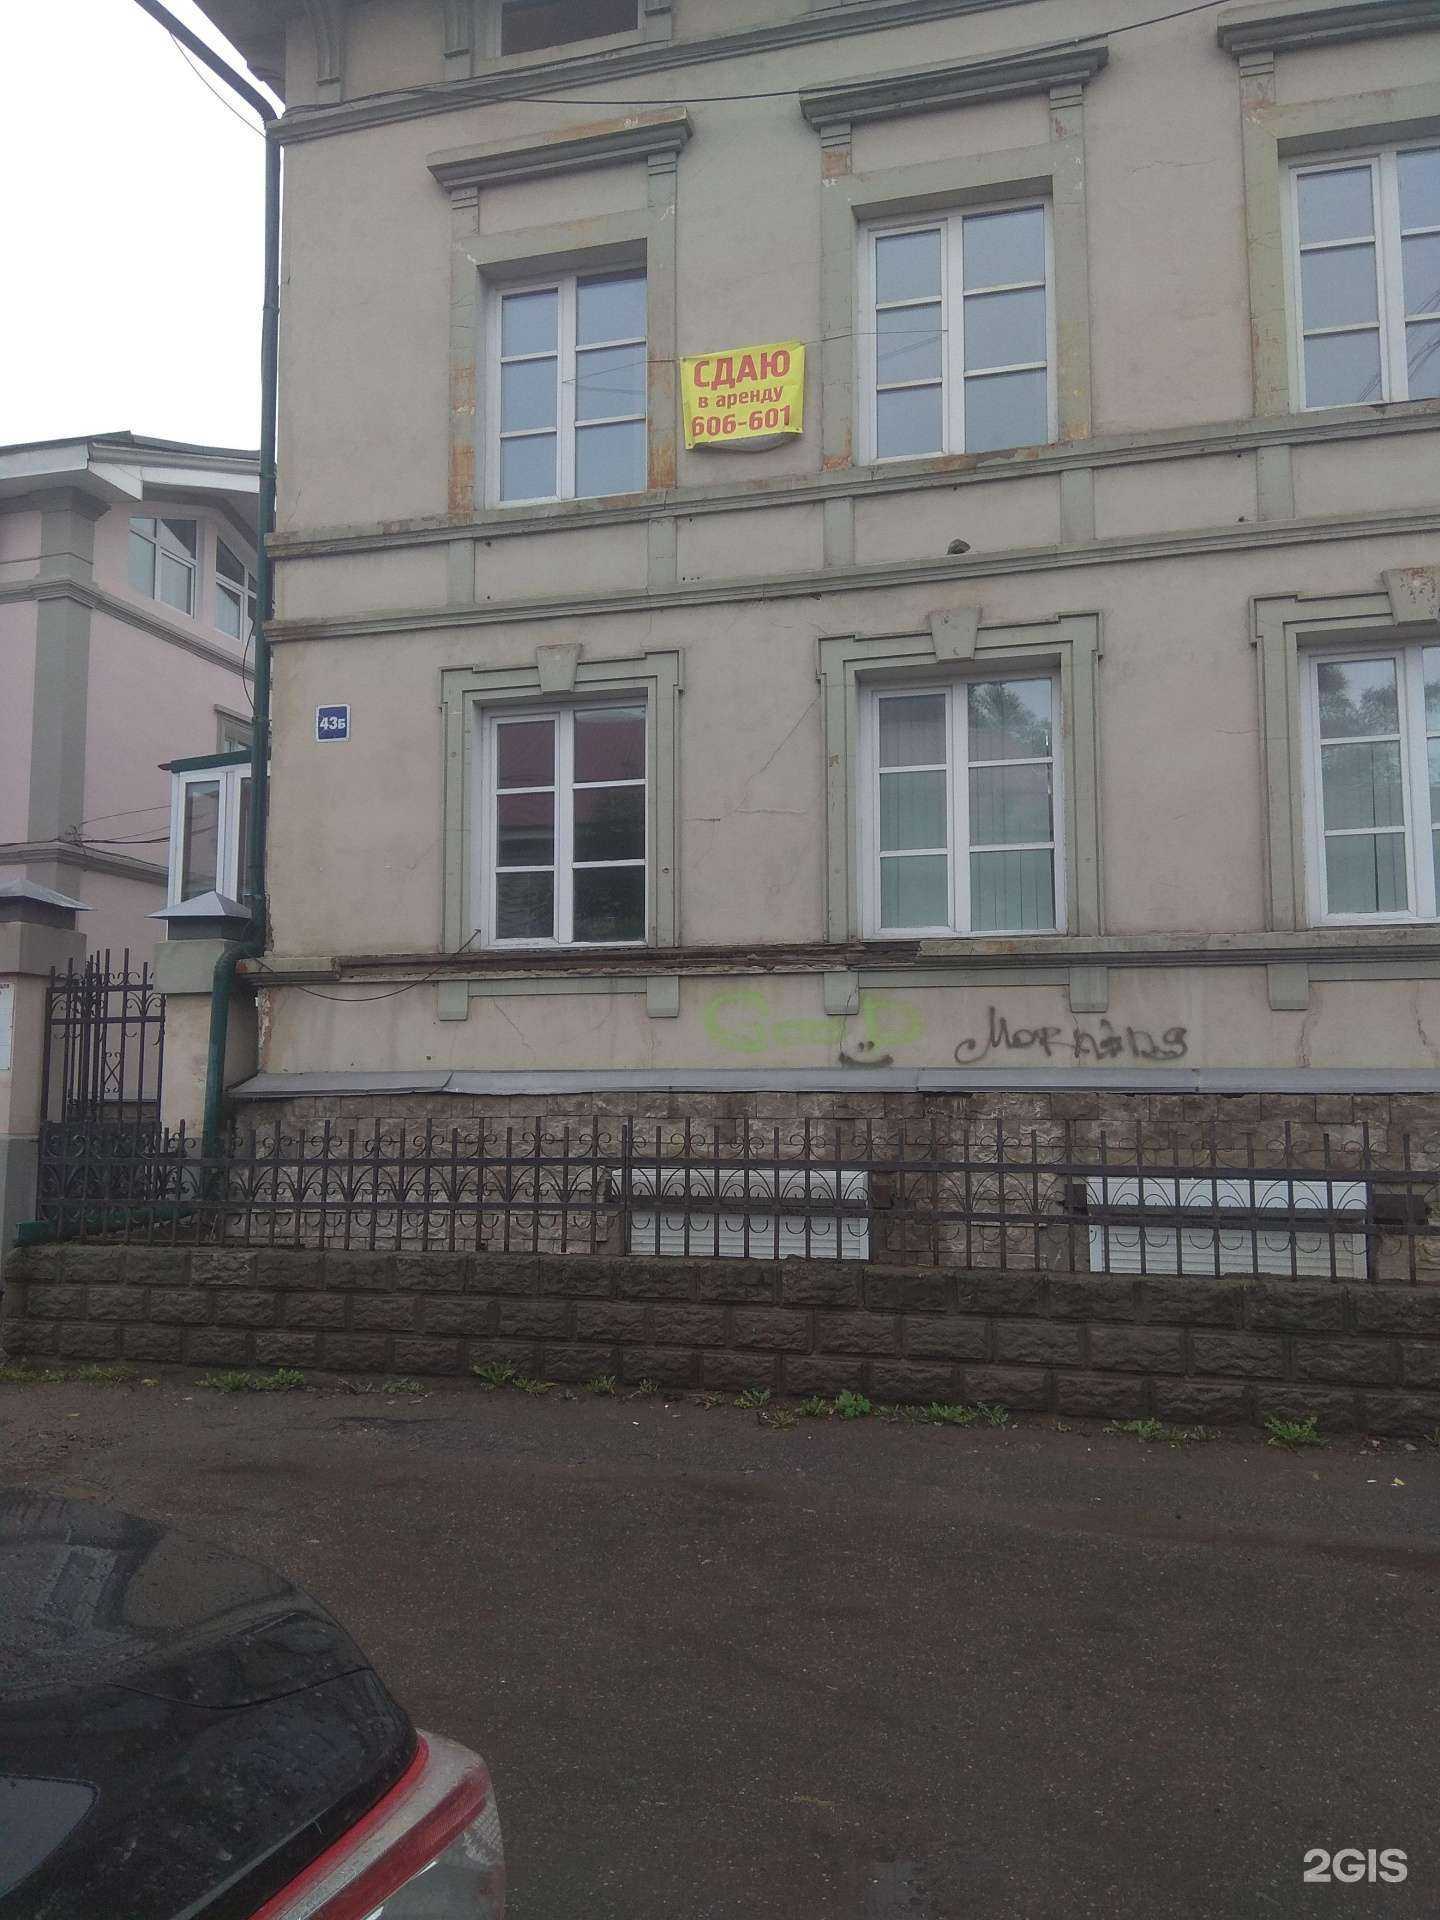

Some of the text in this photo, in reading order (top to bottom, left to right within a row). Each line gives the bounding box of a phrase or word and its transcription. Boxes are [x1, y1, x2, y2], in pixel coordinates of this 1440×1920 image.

[693, 349, 791, 391] СДАЮ
[697, 385, 784, 409] в аренду
[691, 405, 791, 437] 606-601
